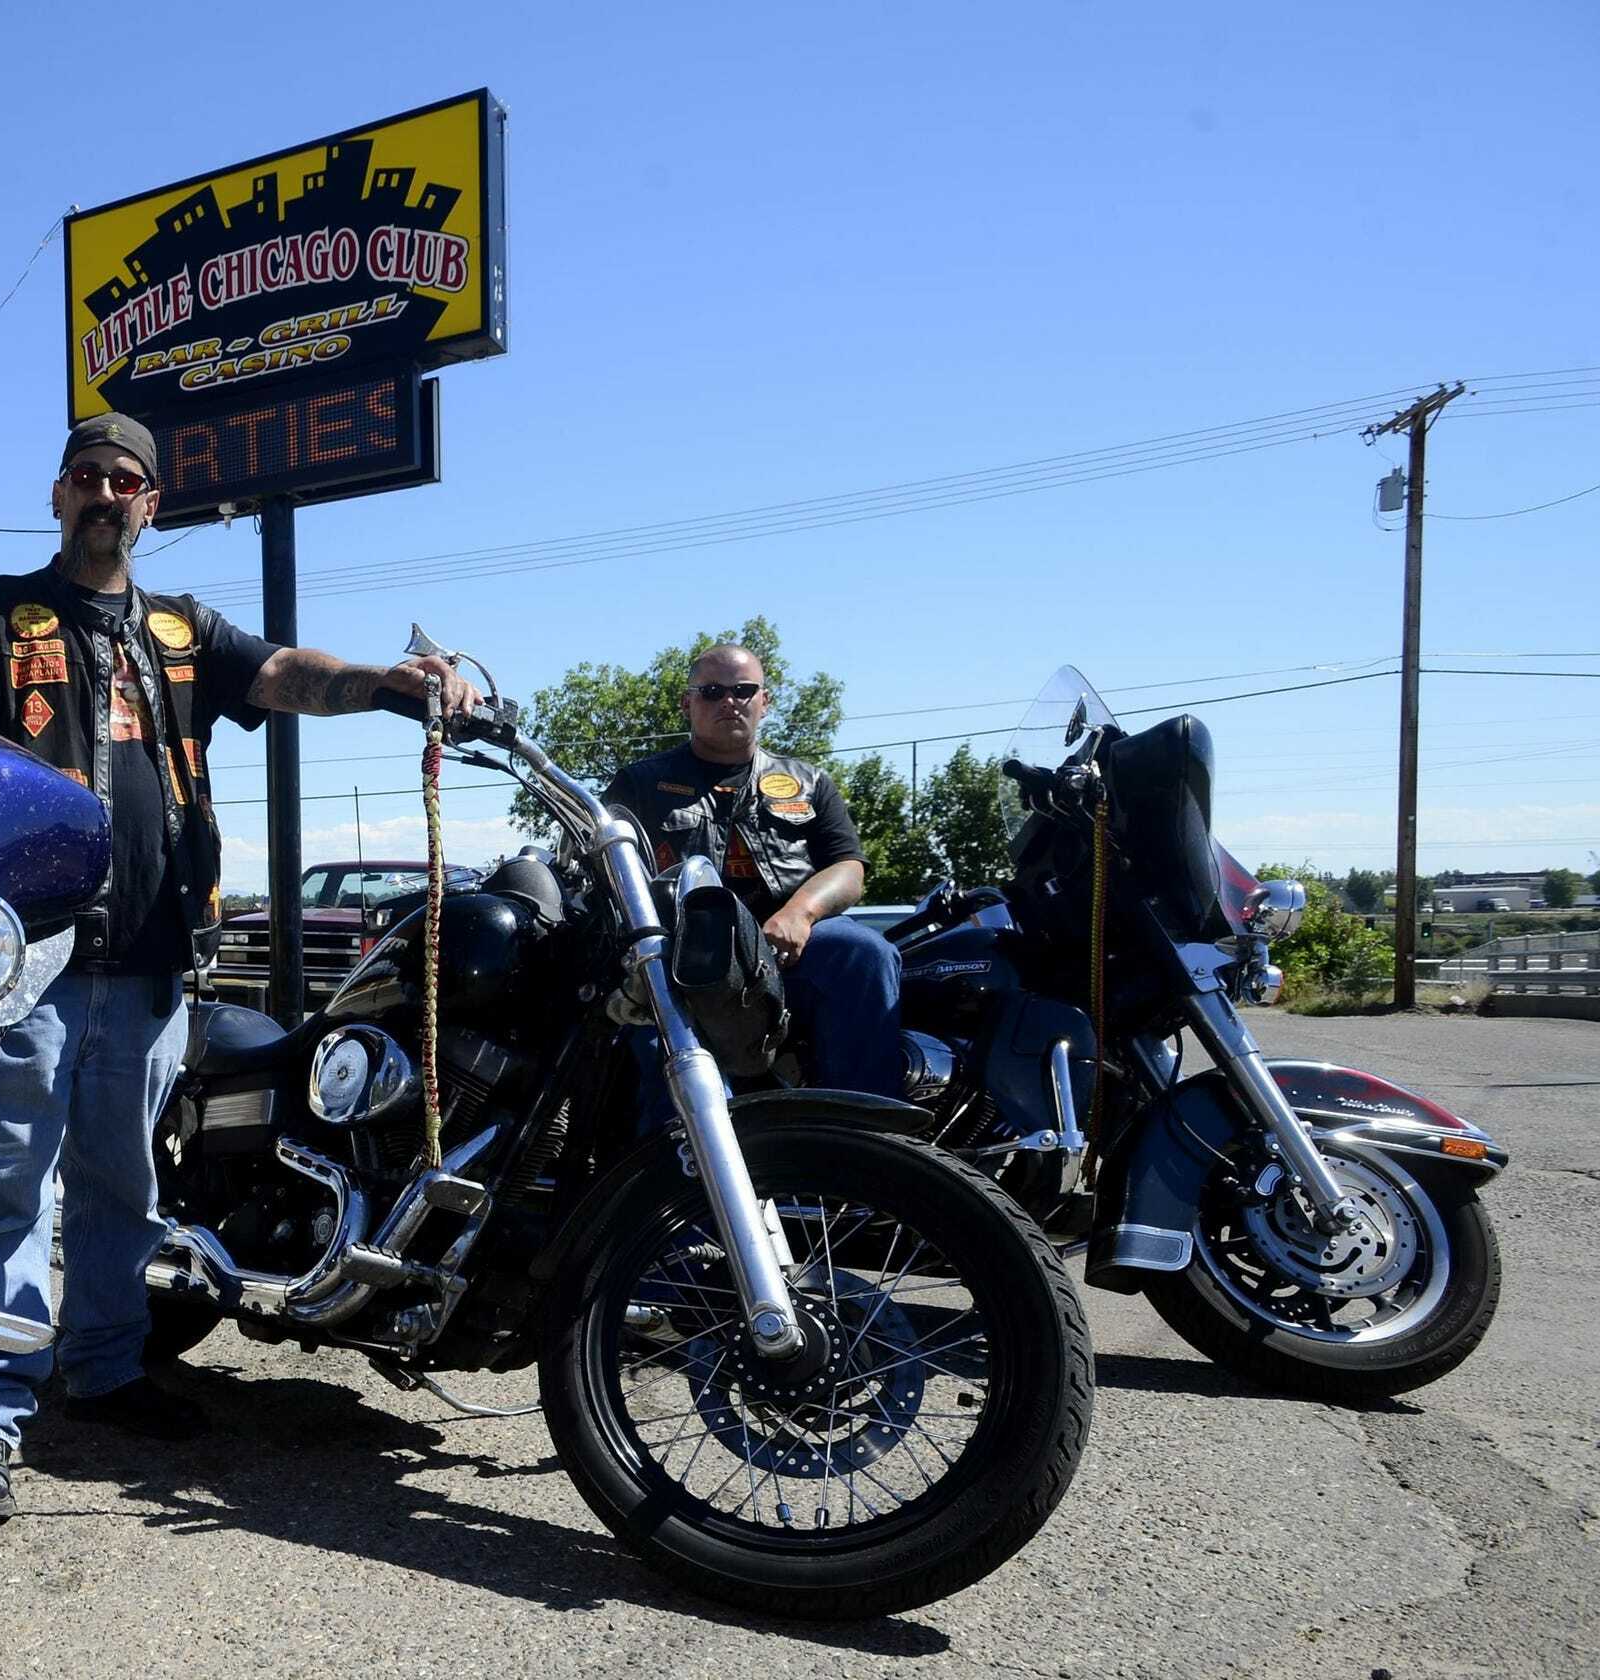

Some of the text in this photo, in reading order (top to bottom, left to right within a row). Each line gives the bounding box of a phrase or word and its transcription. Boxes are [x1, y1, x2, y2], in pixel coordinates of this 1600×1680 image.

[81, 225, 470, 385] LITTLE CHICAGO CLUB
[130, 337, 222, 380] BAR
[258, 293, 409, 348] GRILL
[179, 334, 352, 391] CASINO
[157, 380, 397, 494] RTIES
[27, 700, 43, 713] 13
